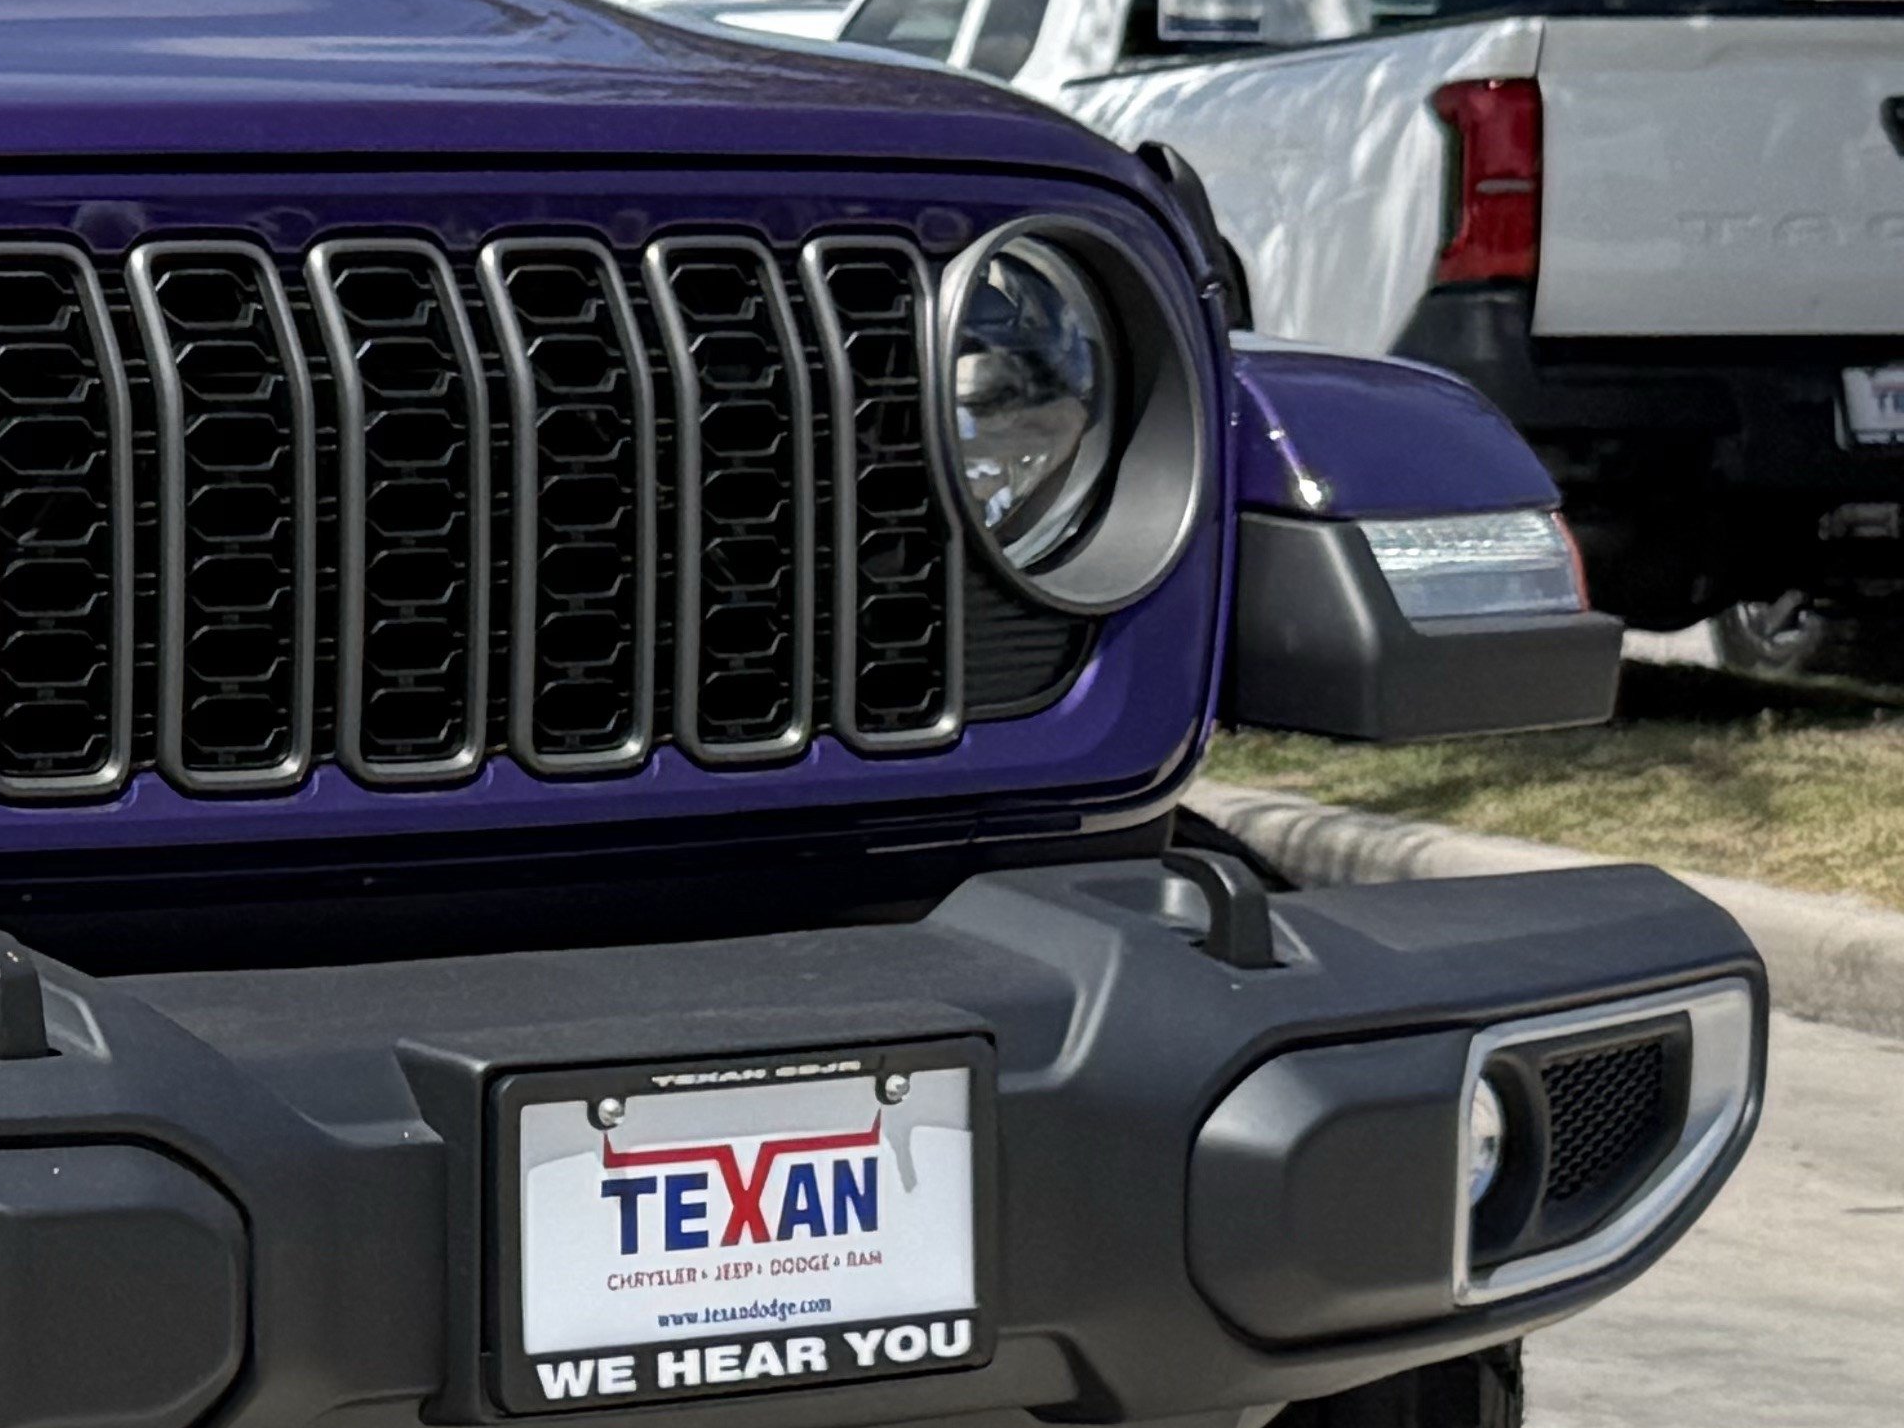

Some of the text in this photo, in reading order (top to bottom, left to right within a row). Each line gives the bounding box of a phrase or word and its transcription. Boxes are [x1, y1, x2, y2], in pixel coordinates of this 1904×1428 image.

[600, 1109, 881, 1255] TEXAN
[715, 1262, 753, 1283] JEEP
[770, 1254, 830, 1278] DODGE
[847, 1250, 883, 1270] RAM
[536, 1318, 974, 1401] WE HEAR YOU
